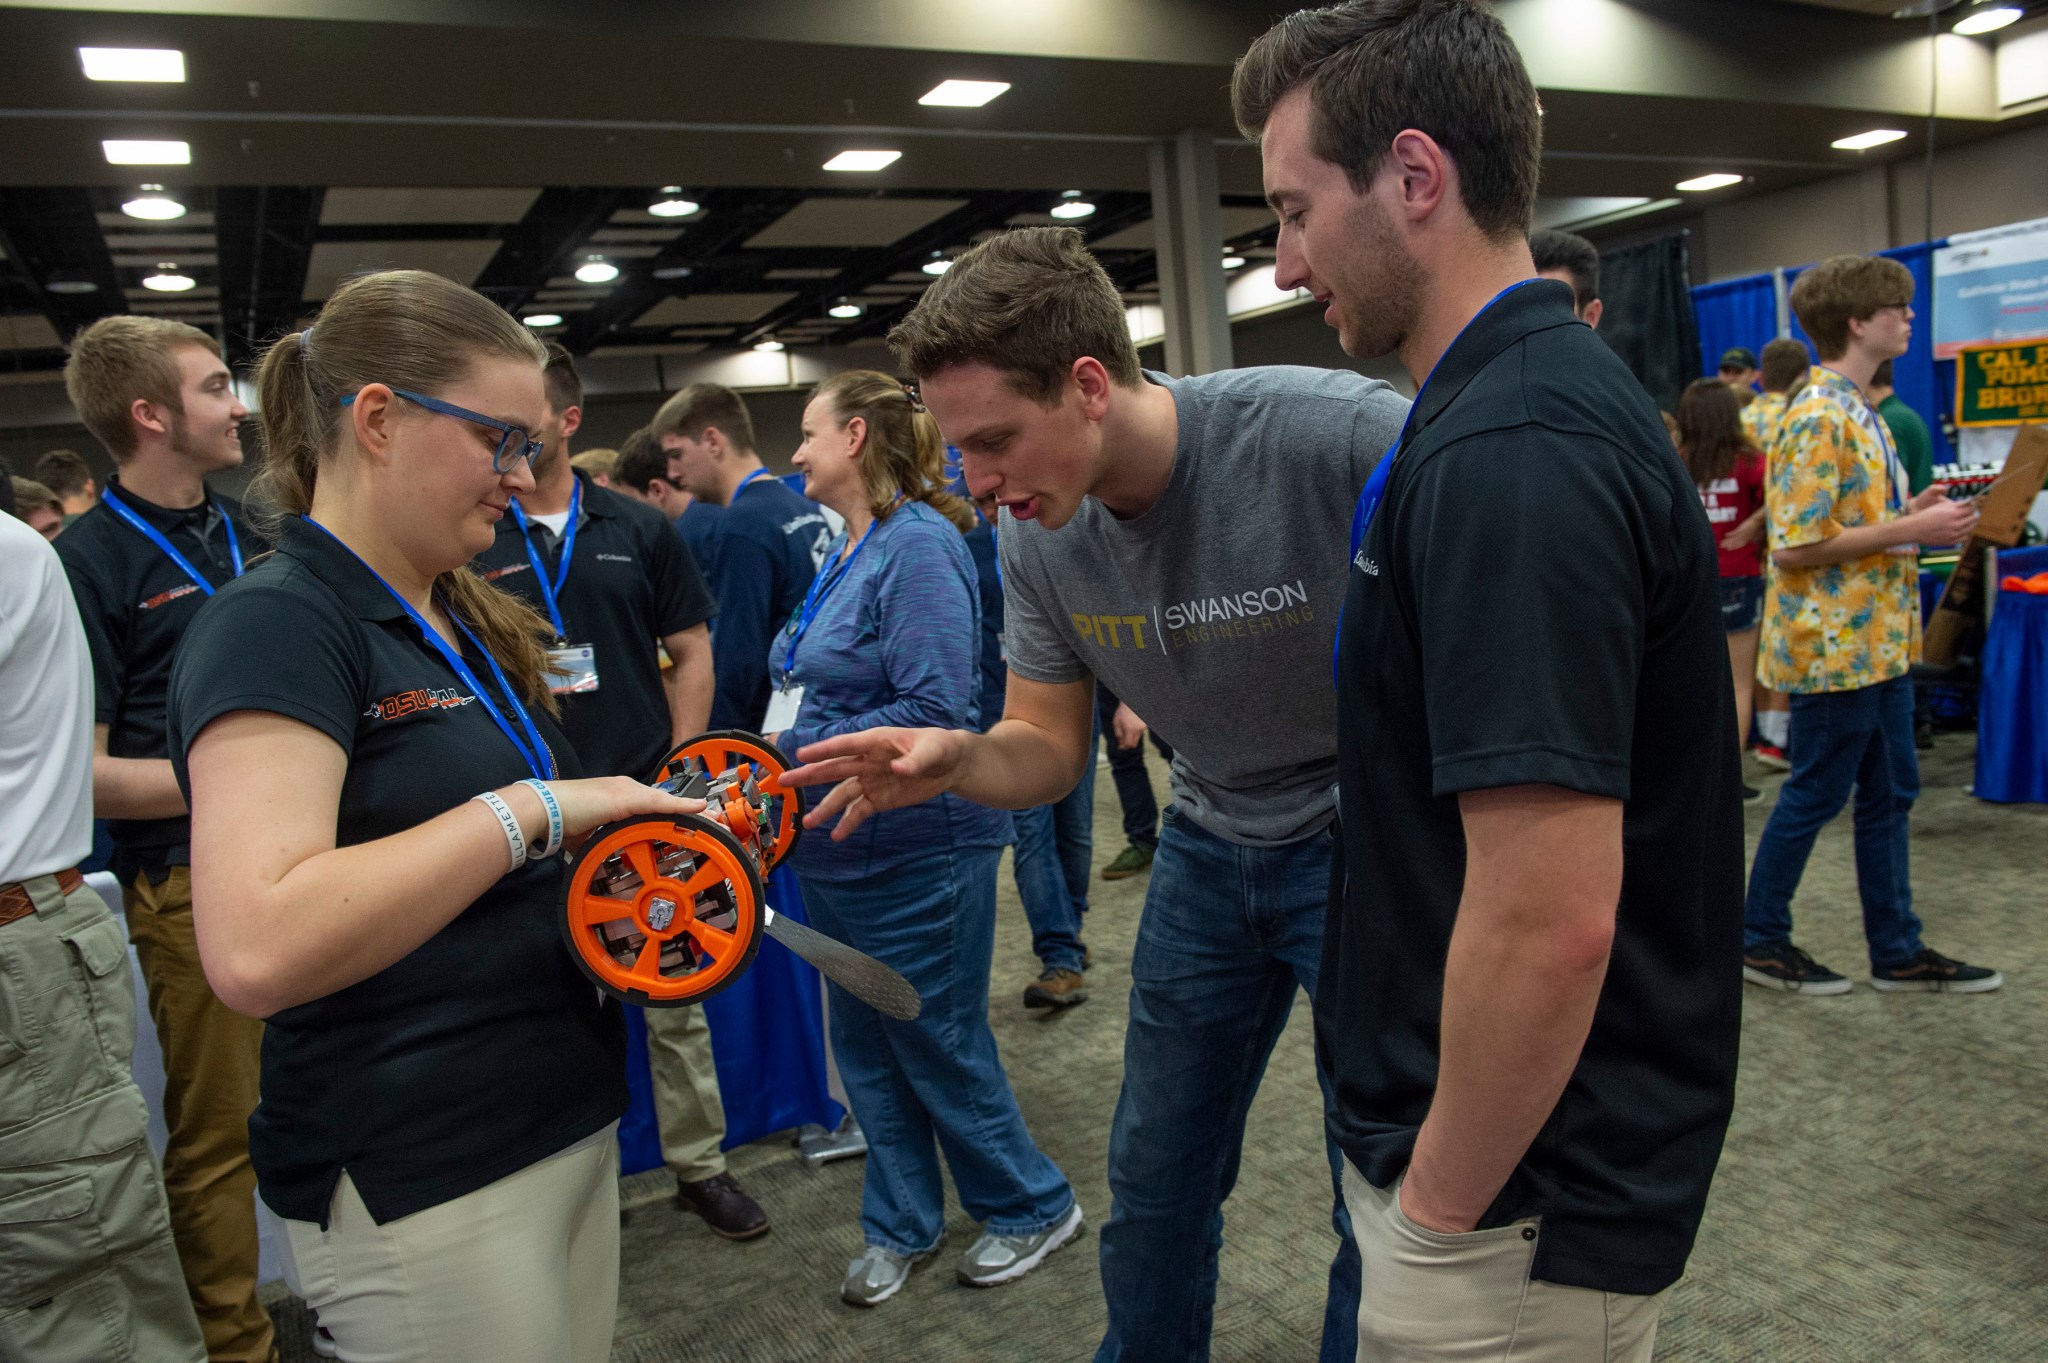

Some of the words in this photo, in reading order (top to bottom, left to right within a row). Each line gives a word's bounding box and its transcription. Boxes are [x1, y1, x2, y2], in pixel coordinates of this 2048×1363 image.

[1976, 349, 2029, 369] CAL
[1165, 580, 1309, 630] SWANSON
[1071, 612, 1148, 649] PITT
[1171, 605, 1315, 648] ENGINEERING
[381, 689, 430, 721] OSU
[542, 790, 560, 818] BLUE
[552, 822, 562, 847] NEW
